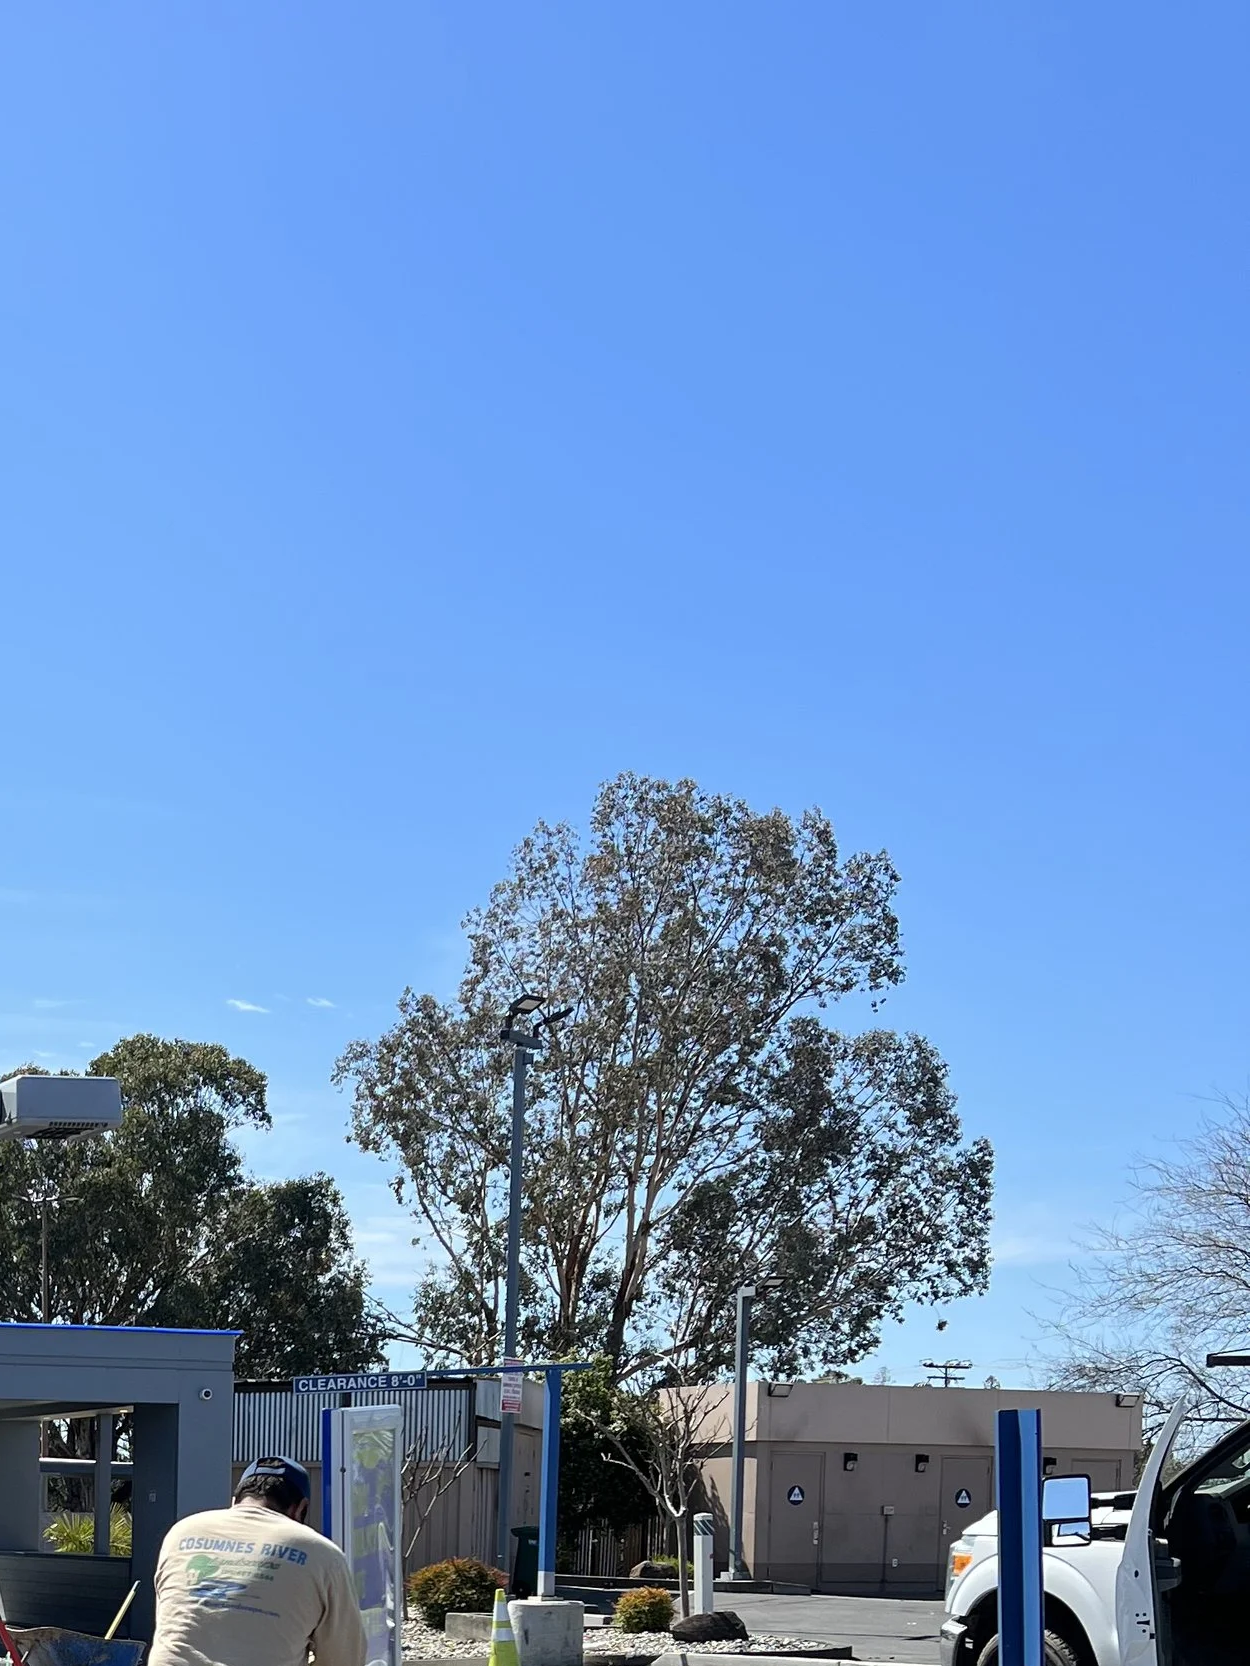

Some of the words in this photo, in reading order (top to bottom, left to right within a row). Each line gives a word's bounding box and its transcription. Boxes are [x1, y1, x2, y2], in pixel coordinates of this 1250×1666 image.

[298, 1376, 387, 1392] CLEARANCE
[391, 1374, 422, 1388] 8'-0"
[179, 1538, 255, 1554] COSUMNES
[261, 1543, 307, 1566] RIVER
